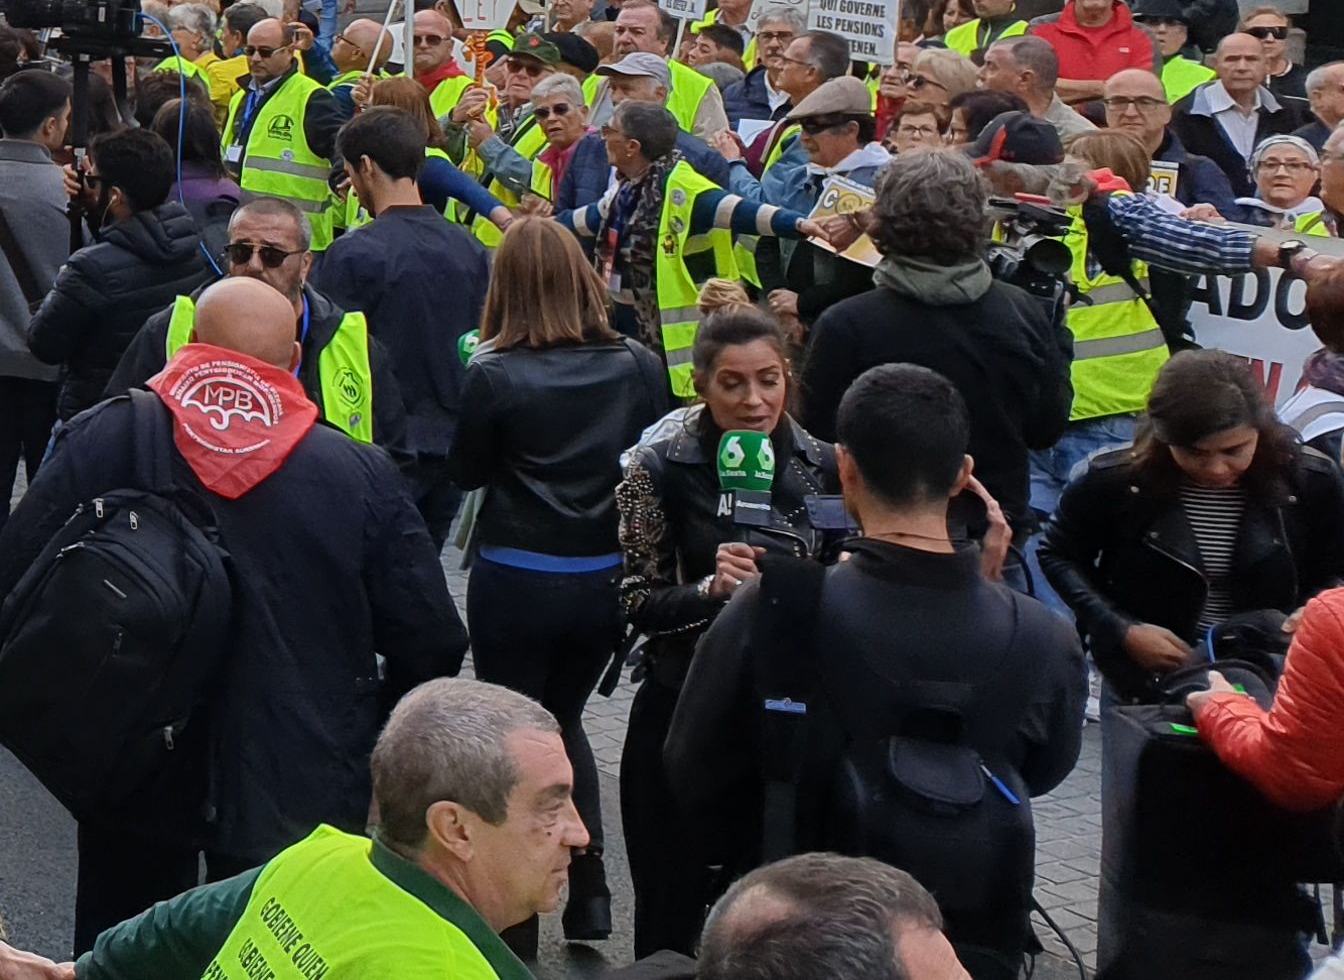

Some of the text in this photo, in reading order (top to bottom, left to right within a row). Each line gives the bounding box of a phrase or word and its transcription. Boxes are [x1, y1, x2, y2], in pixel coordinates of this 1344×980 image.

[839, 0, 885, 18] GOVERNE
[817, 15, 885, 37] LES PENSIONS
[204, 385, 253, 410] MPB
